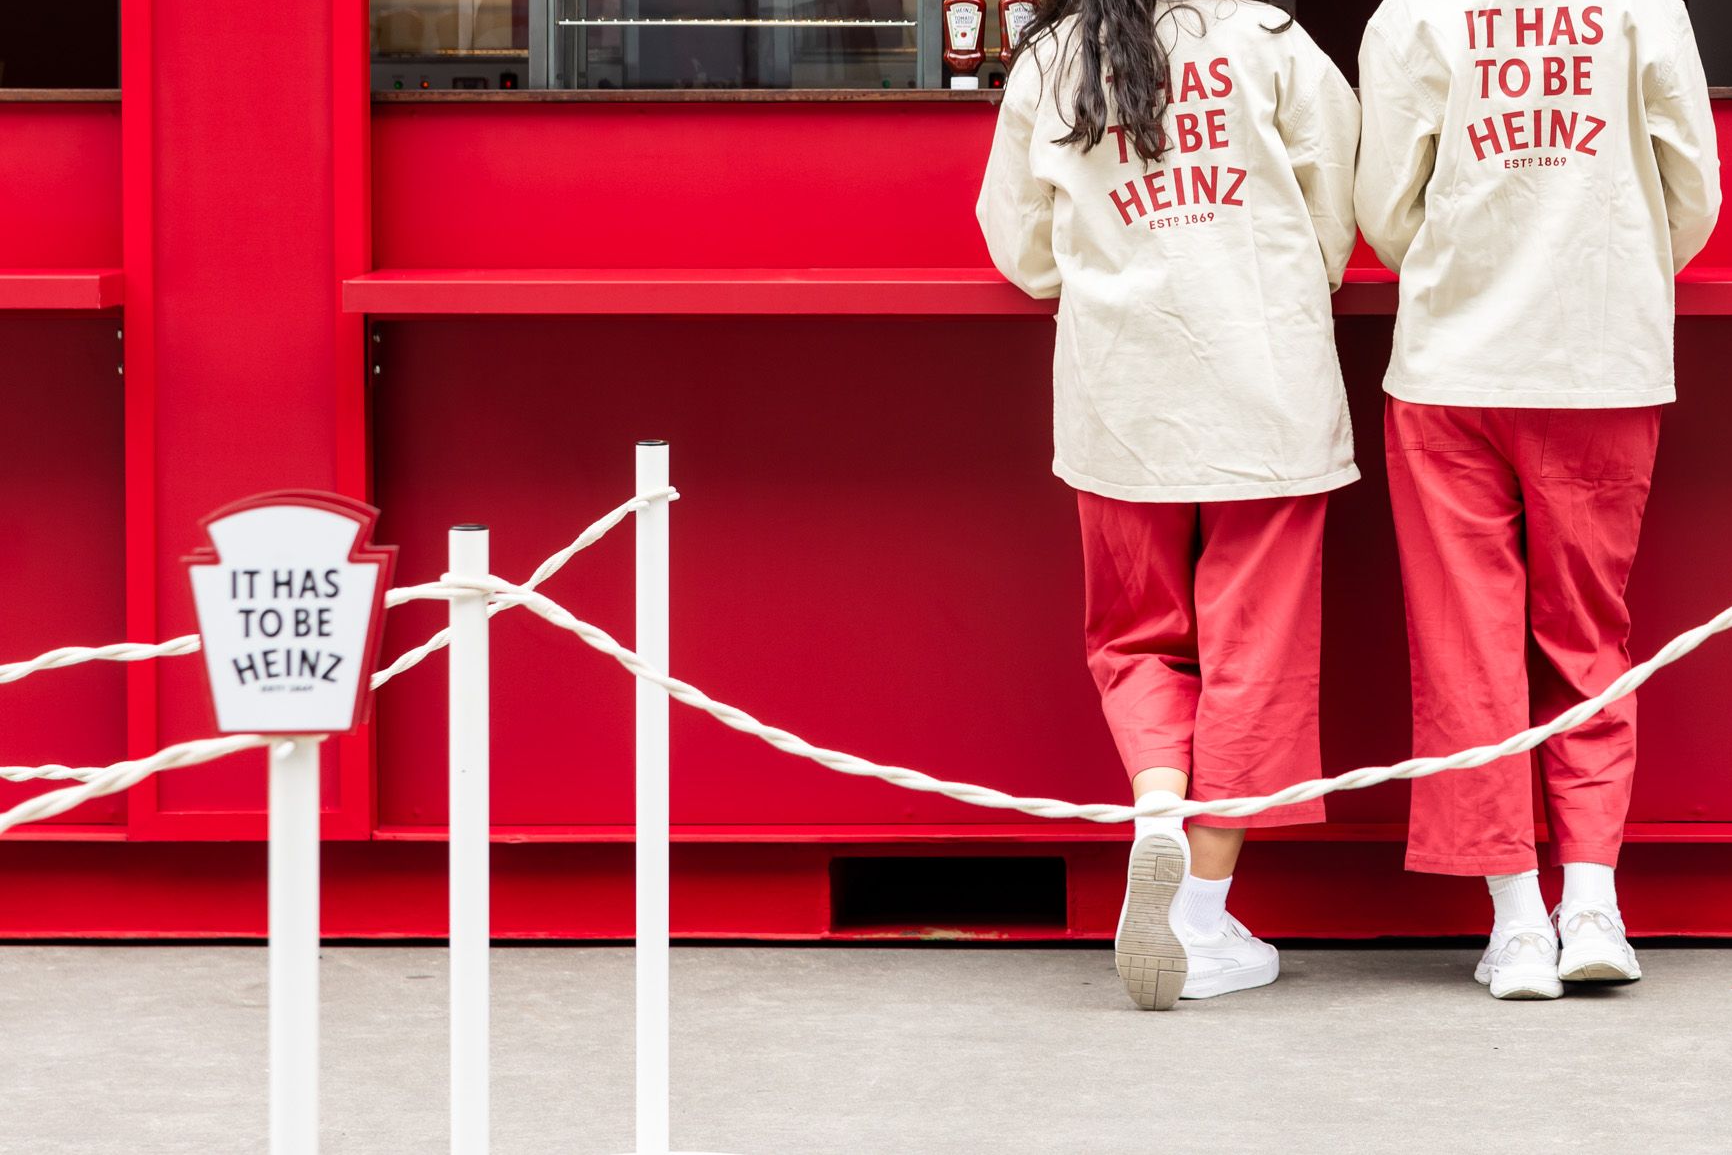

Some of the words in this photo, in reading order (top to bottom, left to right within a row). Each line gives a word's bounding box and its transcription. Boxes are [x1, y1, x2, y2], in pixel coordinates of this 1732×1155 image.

[1464, 9, 1502, 50] IT
[1515, 6, 1604, 47] HAS
[1475, 58, 1531, 99] TO
[1542, 56, 1593, 96] BE
[1175, 109, 1229, 154] BE
[1466, 109, 1607, 161] HEINZ
[1538, 156, 1567, 167] 1869
[1108, 165, 1247, 226] HEINZ
[1184, 212, 1215, 225] 1869
[231, 569, 260, 599] IT
[272, 569, 341, 599] HAS
[238, 609, 282, 638] TO
[294, 608, 332, 637] BE
[232, 649, 344, 685] HEINZ
